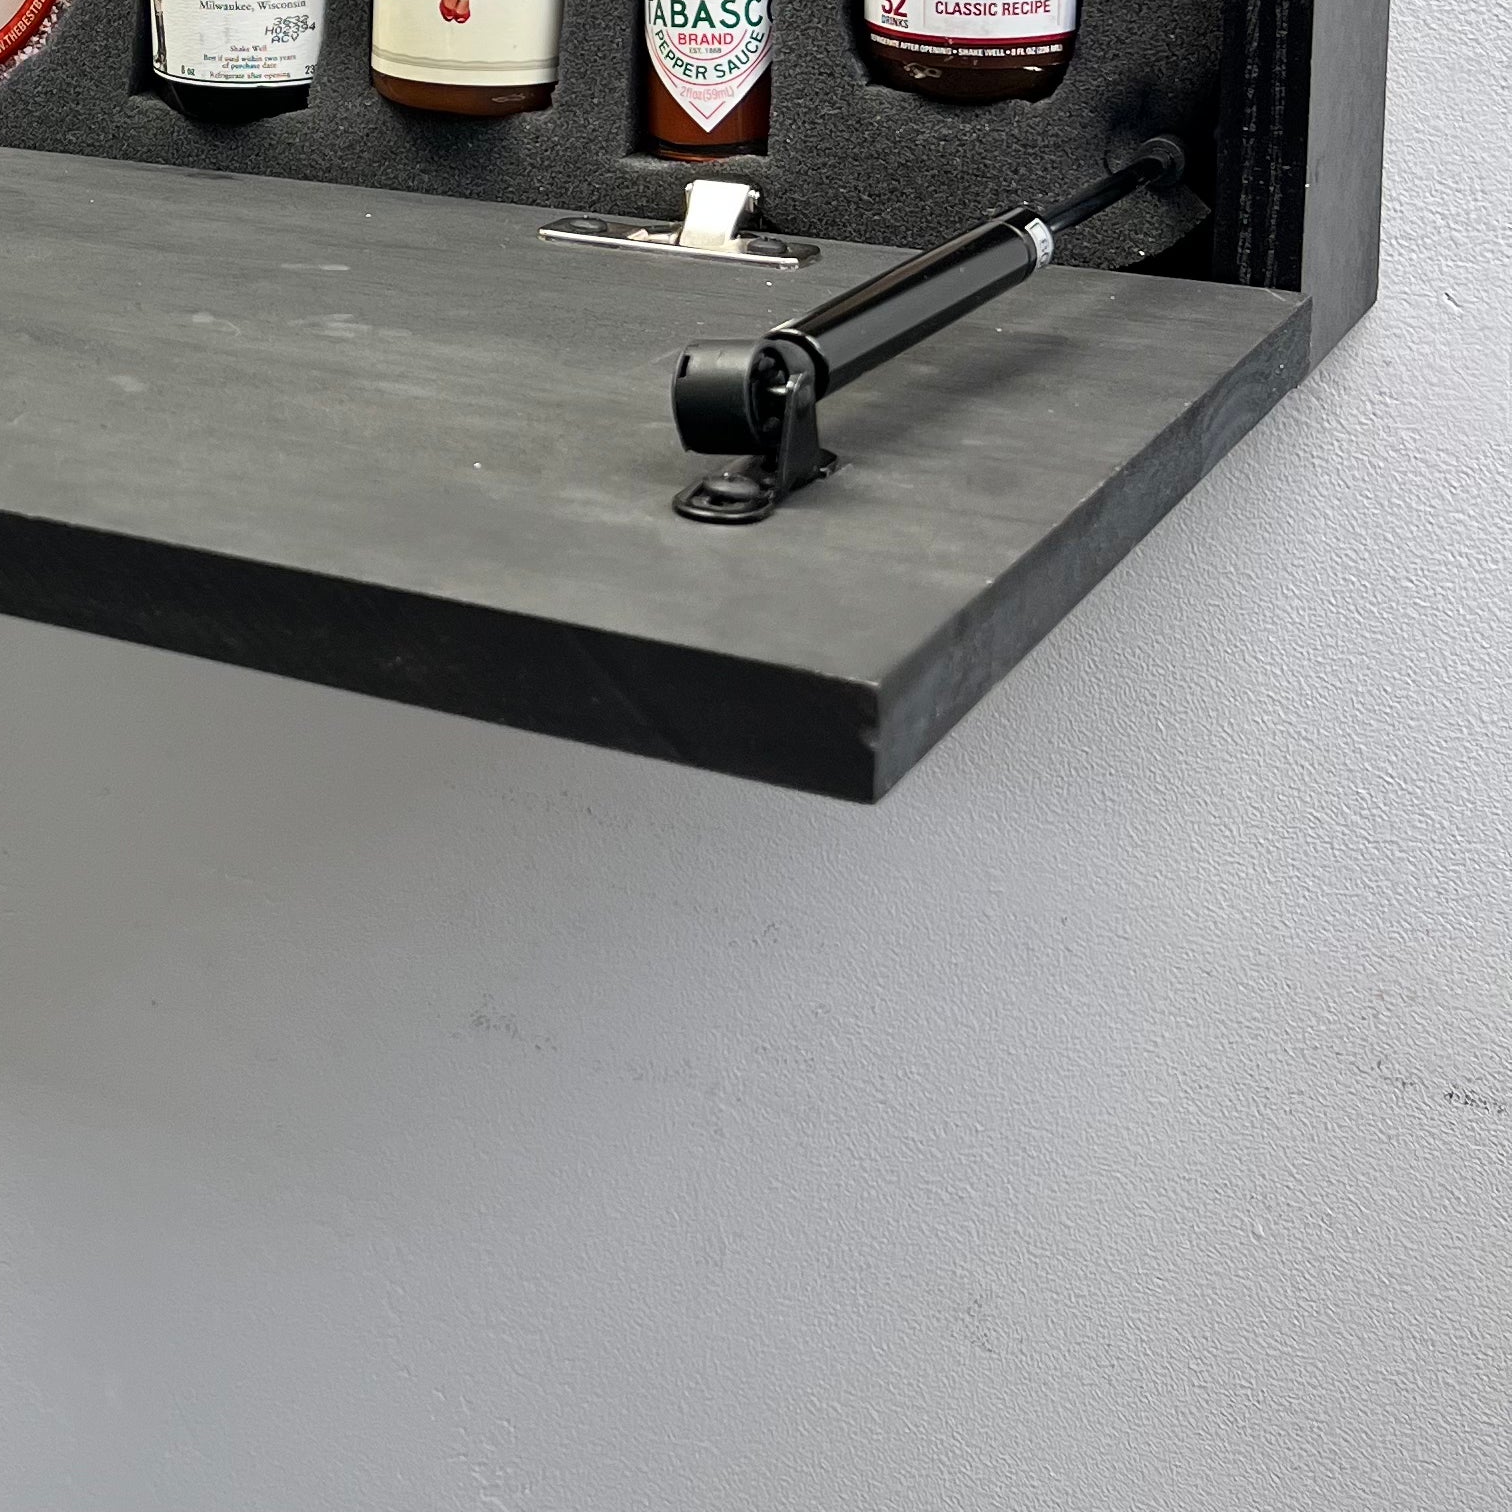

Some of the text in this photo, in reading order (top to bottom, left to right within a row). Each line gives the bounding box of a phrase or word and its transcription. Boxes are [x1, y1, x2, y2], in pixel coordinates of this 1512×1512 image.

[199, 0, 254, 12] Milwaukee,
[935, 0, 998, 17] CLASSIC
[881, 14, 909, 29] DRINKS
[678, 32, 734, 46] BRAND
[655, 29, 765, 80] PEPPER SAUCE
[984, 48, 1006, 56] WELL
